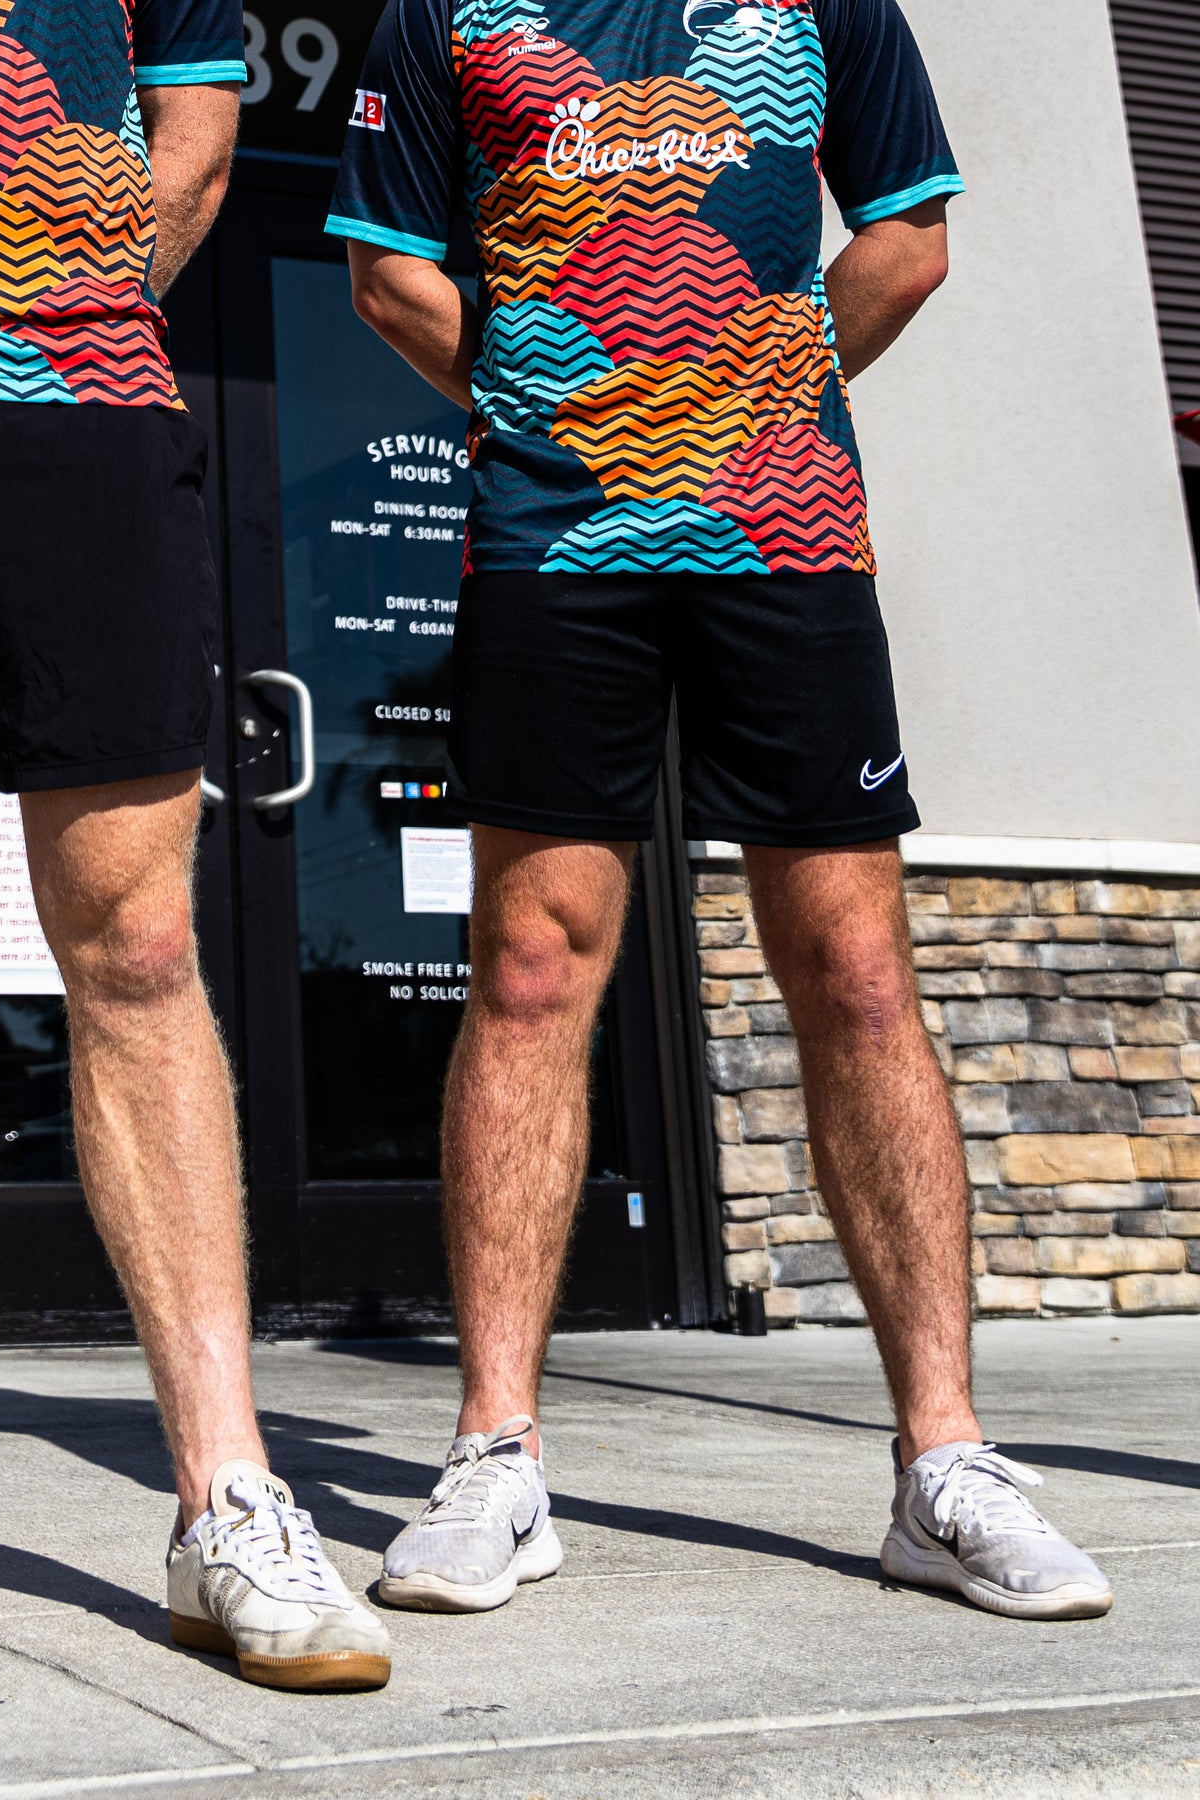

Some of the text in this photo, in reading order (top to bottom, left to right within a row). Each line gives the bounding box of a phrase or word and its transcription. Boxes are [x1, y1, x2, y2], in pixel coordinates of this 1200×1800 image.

[508, 38, 556, 57] hummel
[367, 102, 377, 119] 2
[545, 97, 751, 181] Chick-fil-A
[366, 434, 470, 469] SERVING
[390, 464, 452, 484] HOURS
[374, 501, 426, 517] DINING
[330, 520, 392, 537] MON-SAT
[403, 525, 455, 542] 6:30AM
[334, 616, 397, 633] MON-SAT
[375, 704, 432, 721] CLOSED
[362, 961, 415, 977] SMOKE
[417, 962, 454, 978] FREE
[389, 985, 414, 1000] NO
